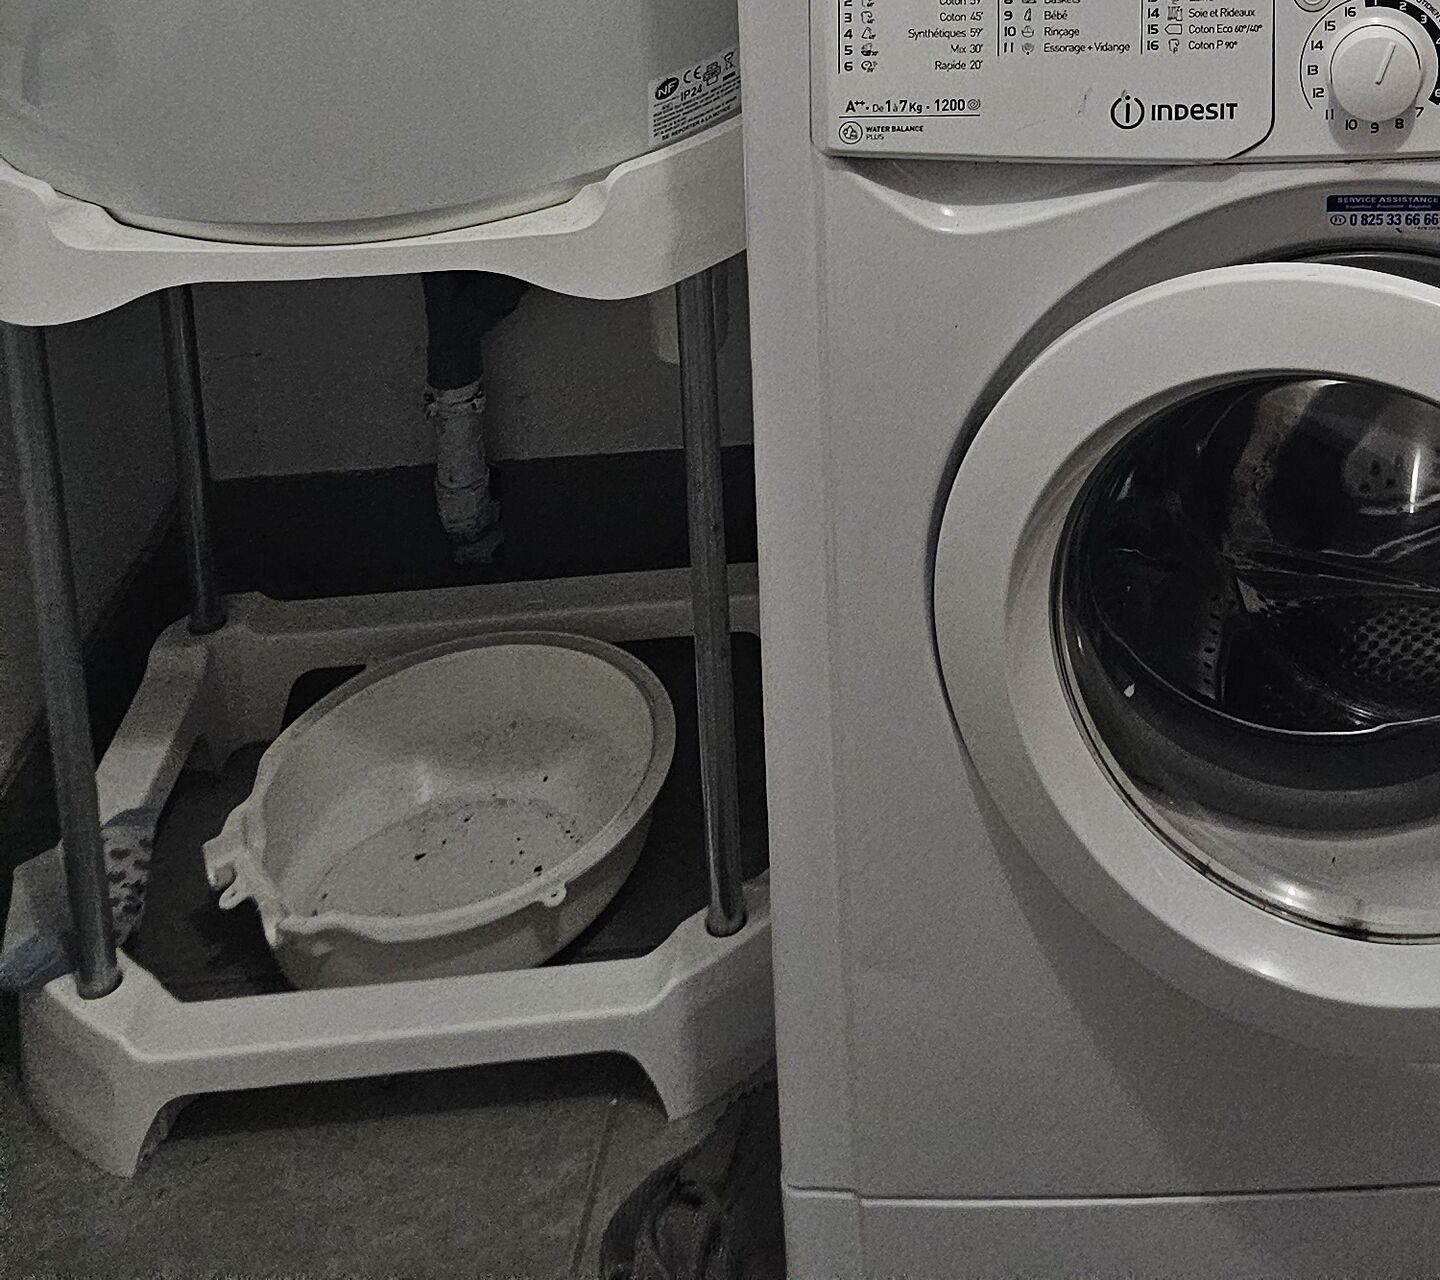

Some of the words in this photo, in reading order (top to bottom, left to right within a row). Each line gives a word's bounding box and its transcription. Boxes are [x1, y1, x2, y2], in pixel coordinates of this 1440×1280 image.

[1400, 2, 1407, 10] 2
[844, 13, 852, 23] 3
[939, 12, 966, 22] Coton
[1004, 11, 1013, 20] 9
[1044, 9, 1068, 20] Bébé
[1147, 8, 1159, 18] 14
[1188, 8, 1208, 18] Soie
[1209, 8, 1218, 18] et
[1220, 7, 1256, 17] Rideaux
[1344, 7, 1356, 17] 16
[1420, 15, 1427, 23] 3
[1147, 24, 1159, 34] 15
[1188, 24, 1215, 34] Coton
[1216, 24, 1233, 34] Eco
[1324, 21, 1336, 31] 15
[844, 29, 853, 39] 4
[908, 28, 966, 40] Synthétiques
[1004, 26, 1016, 37] 10
[1044, 26, 1080, 38] Rinçage
[844, 45, 853, 55] 5
[950, 44, 966, 53] Mix
[1004, 42, 1014, 53] 11
[1043, 42, 1086, 54] Essorage
[1094, 42, 1130, 54] Vidange
[1147, 40, 1159, 51] 16
[1188, 40, 1215, 50] Coton
[1311, 41, 1323, 51] 14
[844, 61, 853, 71] 6
[934, 60, 966, 72] Rapide
[1307, 65, 1318, 75] 13
[657, 81, 676, 98] NF
[1313, 88, 1324, 98] 12
[872, 104, 884, 112] De
[900, 100, 908, 112] 7
[909, 102, 923, 114] Kg
[934, 99, 965, 111] 1200
[1415, 107, 1424, 117] 7
[1325, 109, 1334, 120] 11
[866, 125, 890, 133] WATER
[1345, 119, 1358, 130] 10
[1370, 123, 1379, 133] 9
[1395, 119, 1404, 129] 8
[1350, 214, 1357, 226] 0
[1361, 213, 1384, 226] 825
[1386, 213, 1401, 226] 33
[1405, 213, 1420, 226] 66
[1424, 213, 1439, 226] 66
